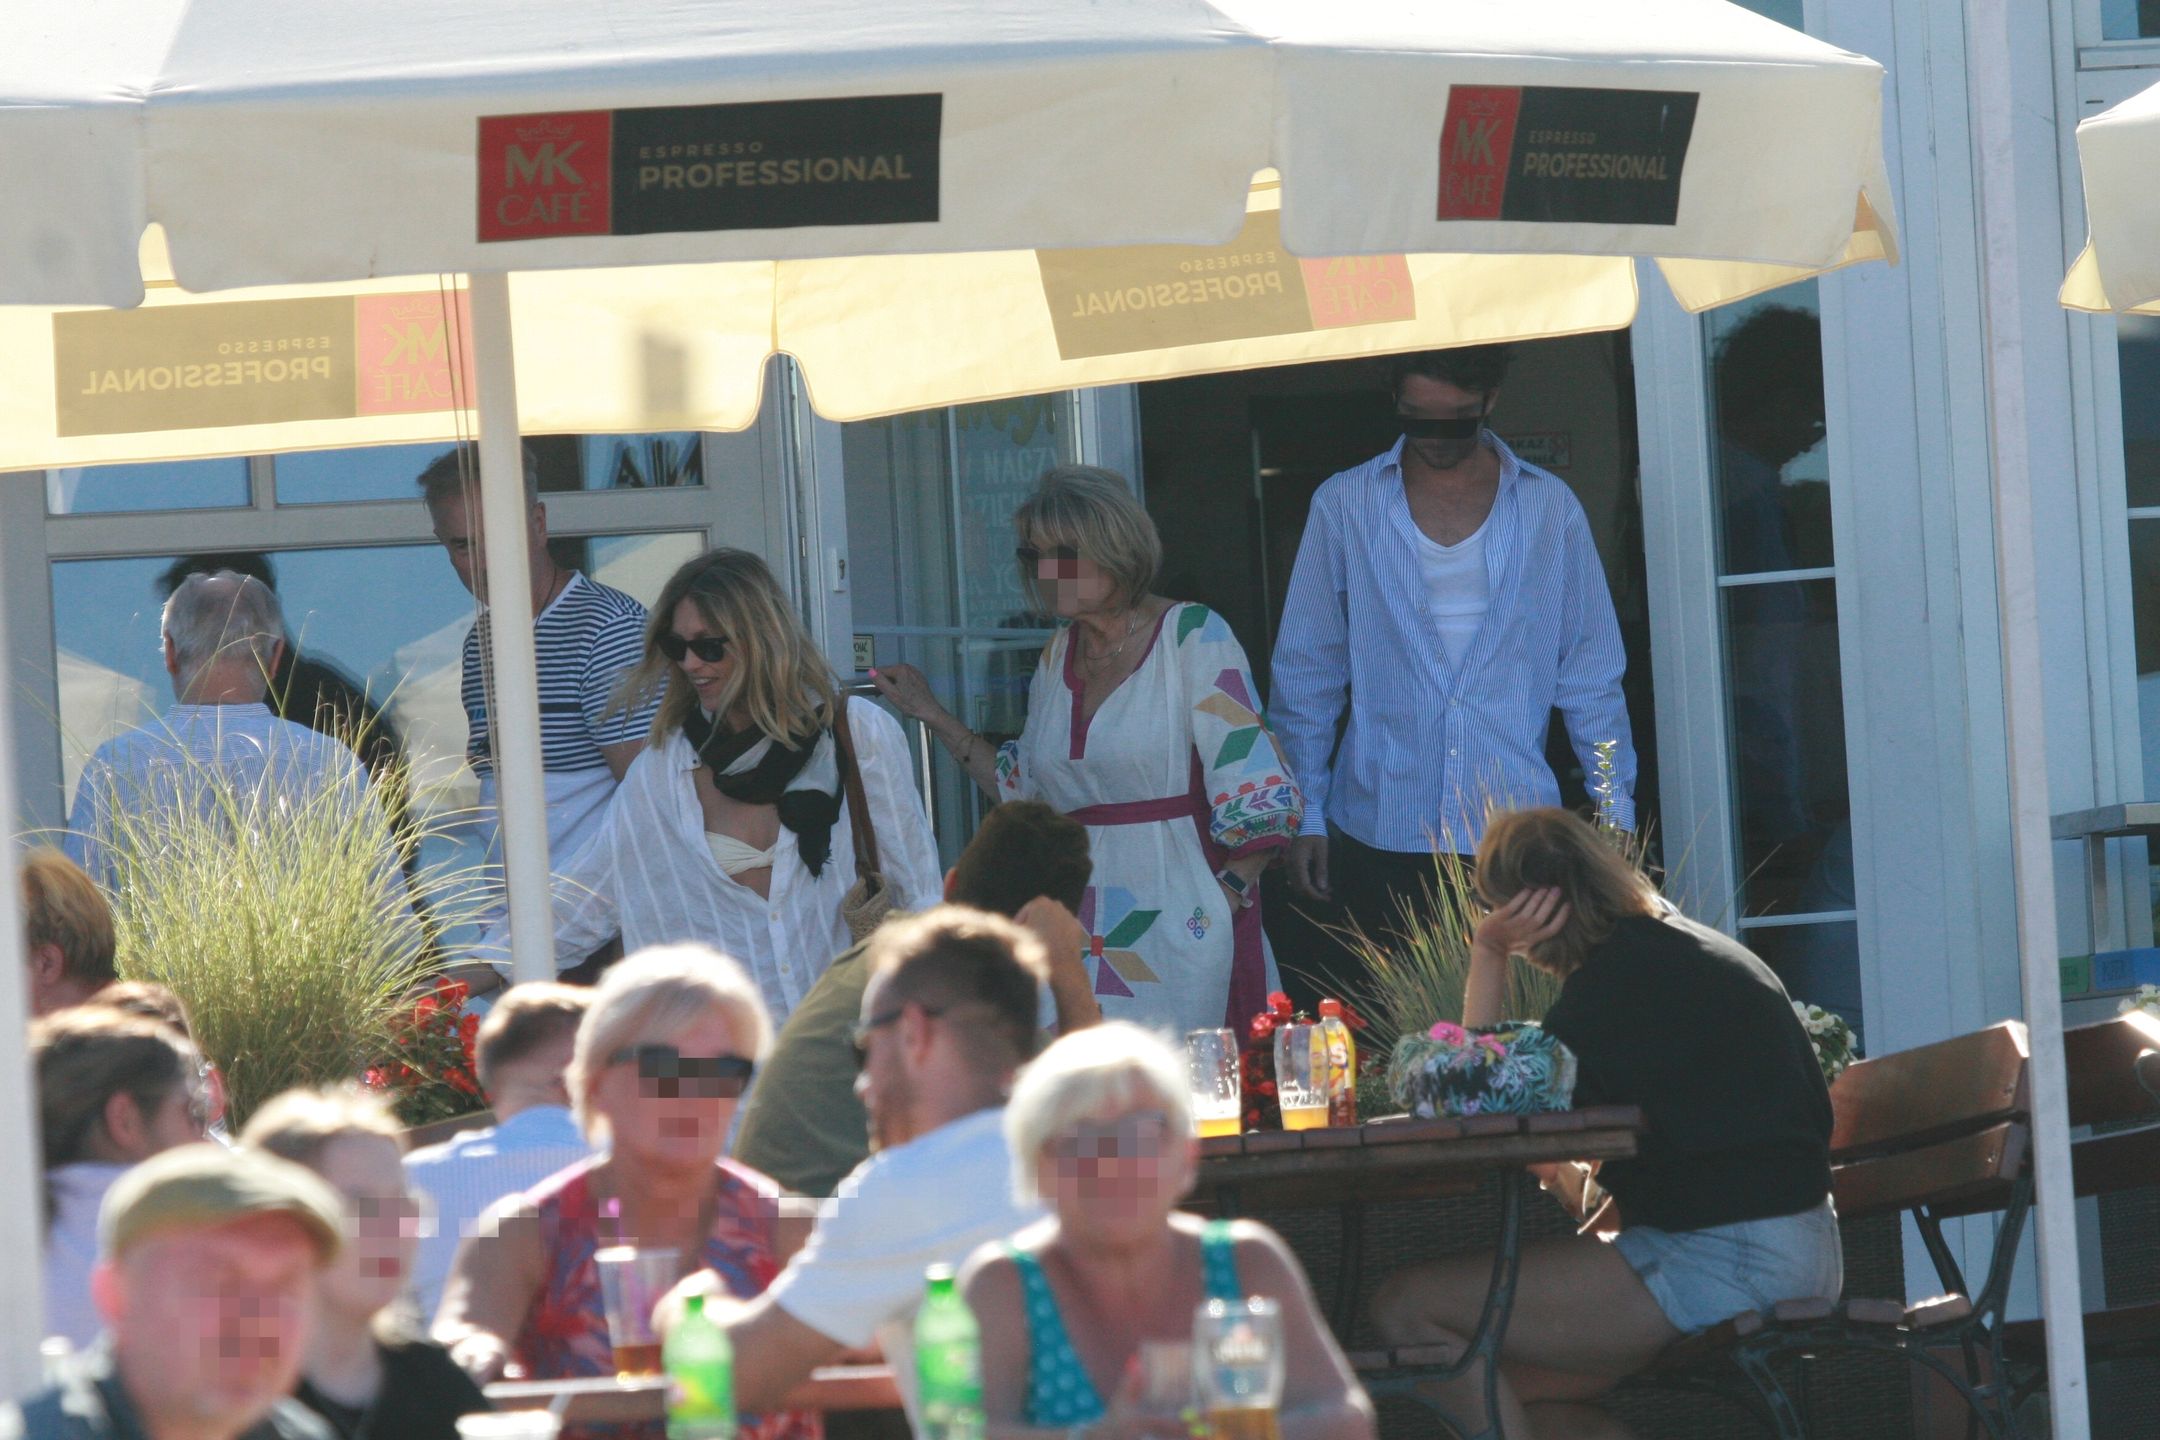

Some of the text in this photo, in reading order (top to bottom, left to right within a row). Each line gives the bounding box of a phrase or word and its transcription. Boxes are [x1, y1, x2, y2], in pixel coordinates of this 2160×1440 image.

[639, 141, 763, 159] ESPRESSO
[1451, 119, 1503, 166] MK
[1528, 130, 1596, 145] ESPRESSO
[505, 140, 584, 189] MK
[639, 154, 911, 190] PROFESSIONAL
[1522, 152, 1668, 181] PROFESSIONAL
